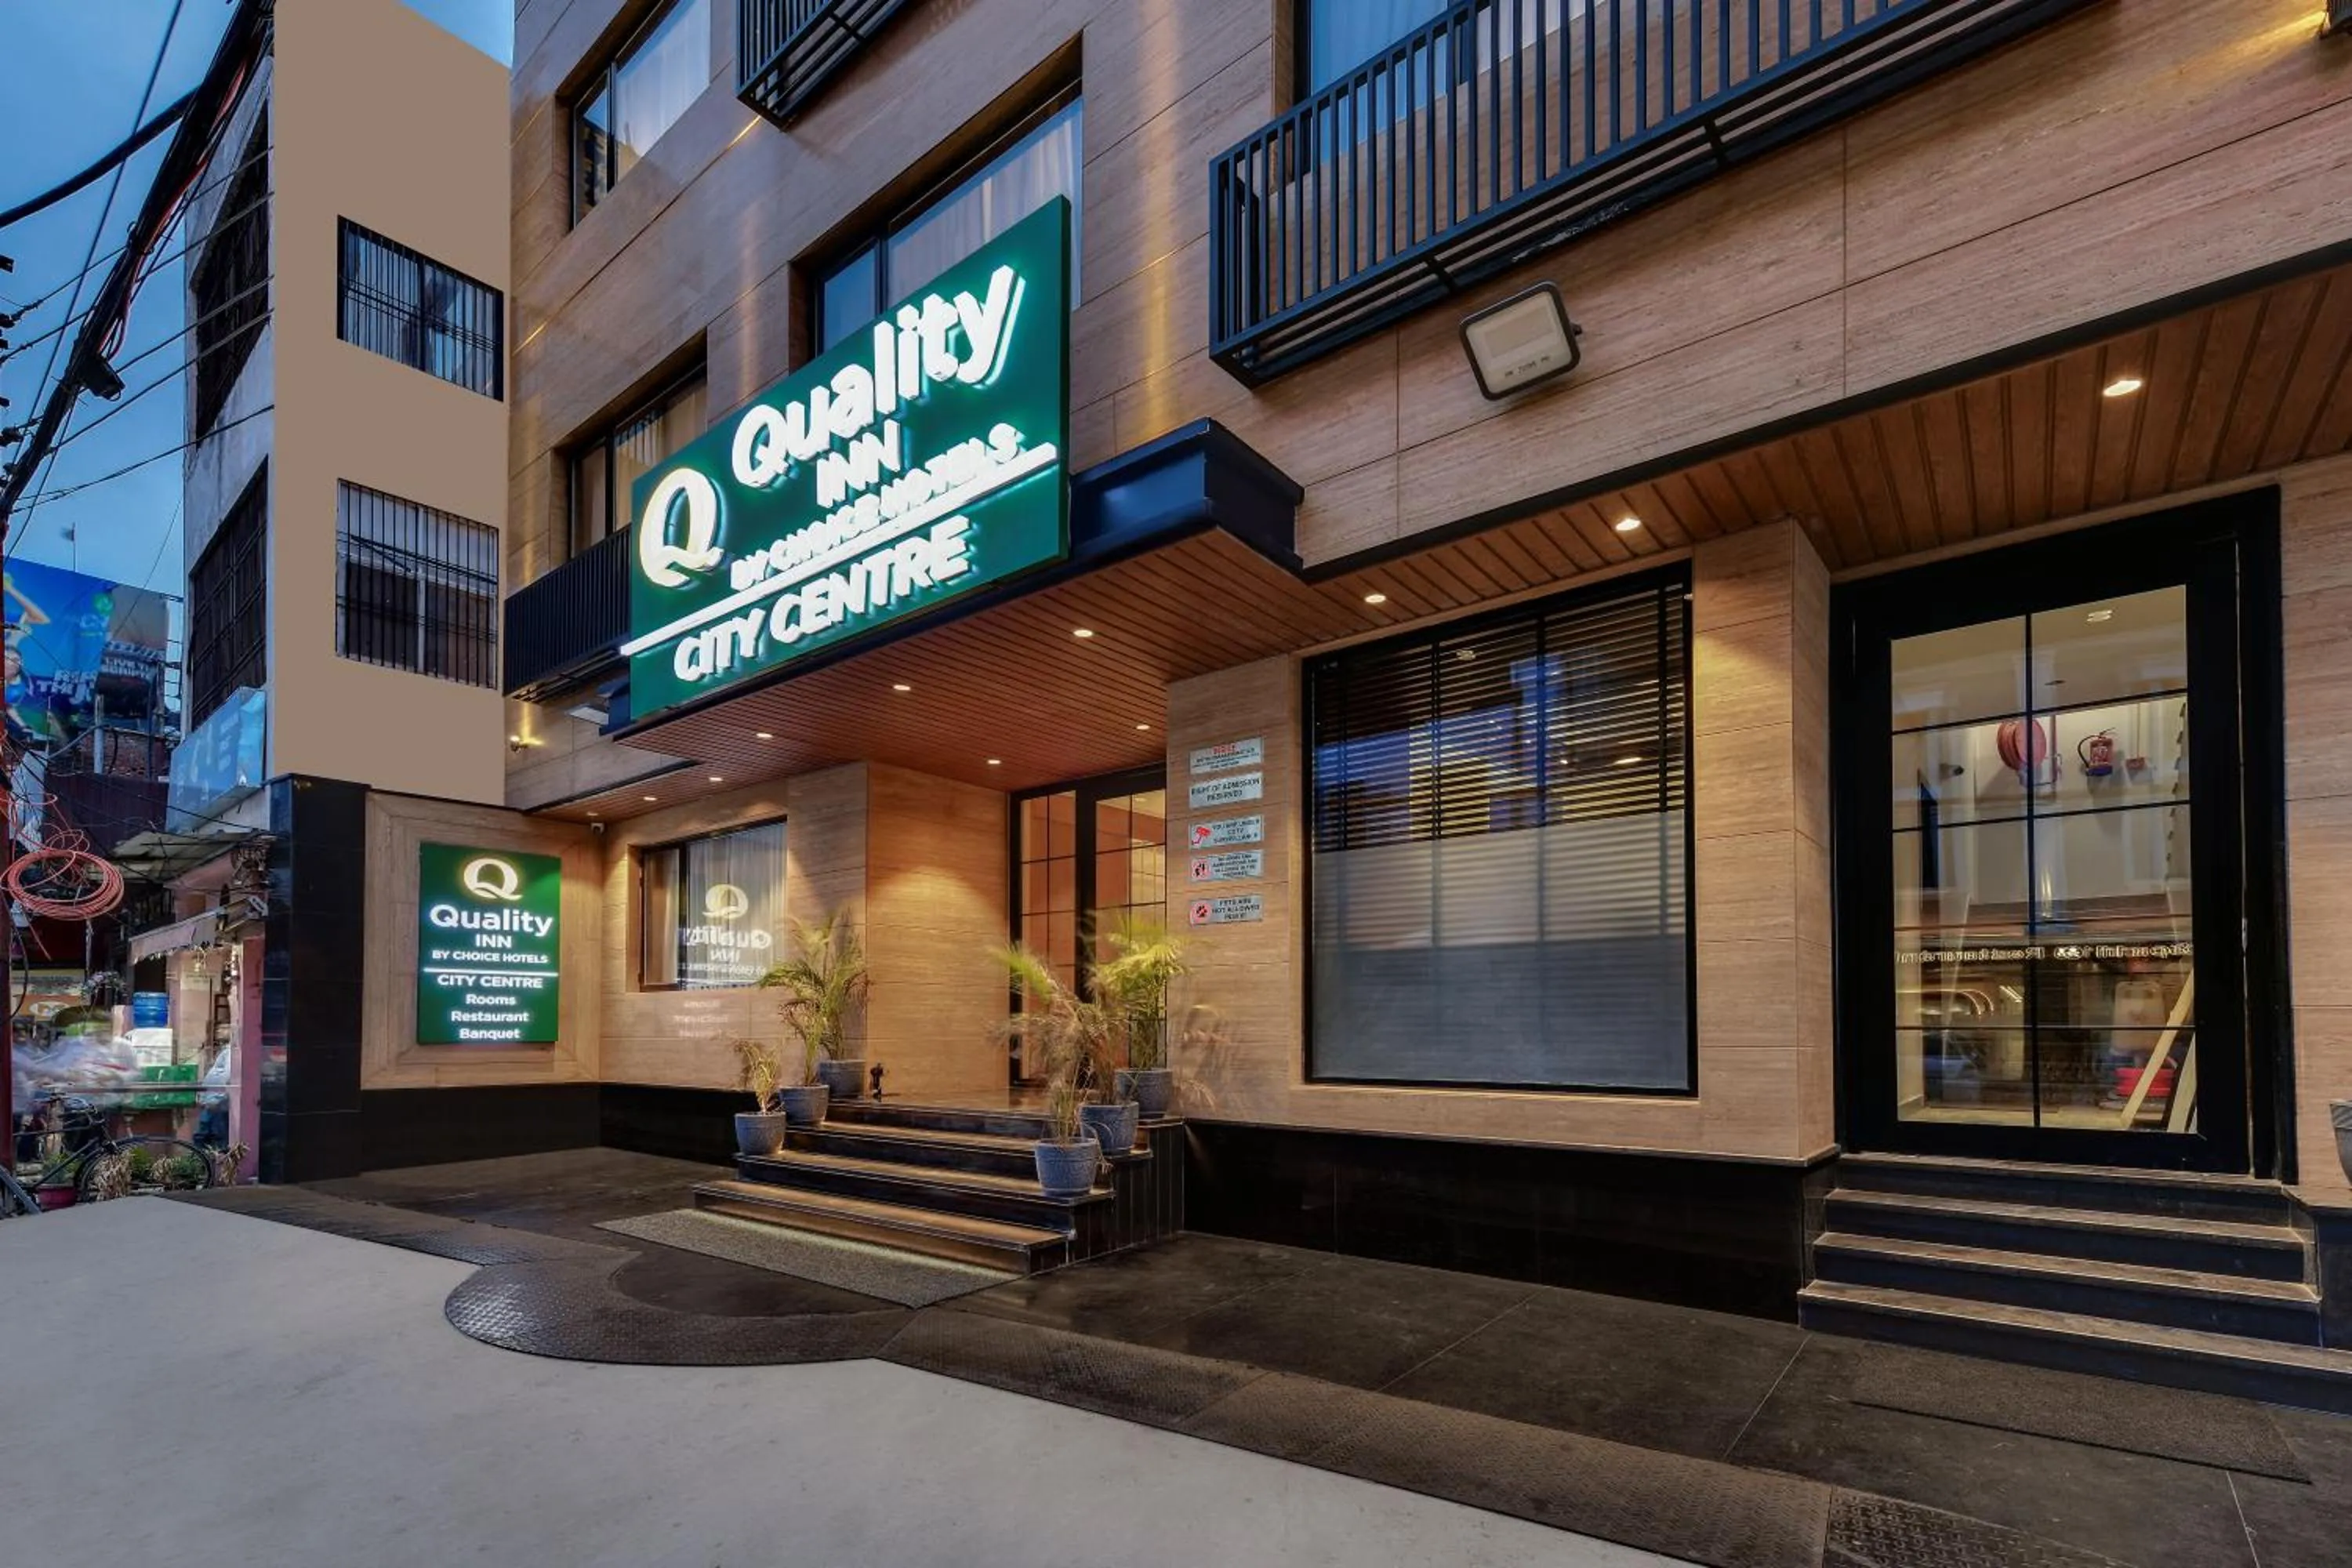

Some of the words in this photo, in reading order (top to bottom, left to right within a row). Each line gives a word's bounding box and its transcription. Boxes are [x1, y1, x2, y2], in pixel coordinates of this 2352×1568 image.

[732, 264, 1019, 488] Quality
[816, 419, 900, 509] INN
[640, 468, 724, 588] Q
[674, 608, 765, 681] CITY
[769, 515, 971, 644] CENTRE
[463, 857, 523, 901] Q
[430, 904, 554, 937] Quality
[475, 934, 512, 948] INN
[431, 949, 451, 960] BY
[452, 950, 500, 962] CHOICE
[503, 953, 549, 964] HOTELS
[437, 974, 477, 986] CITY
[479, 975, 543, 989] CENTRE
[466, 993, 517, 1006] Rooms
[451, 1010, 530, 1023] Restaurant
[459, 1027, 521, 1040] Banquet
